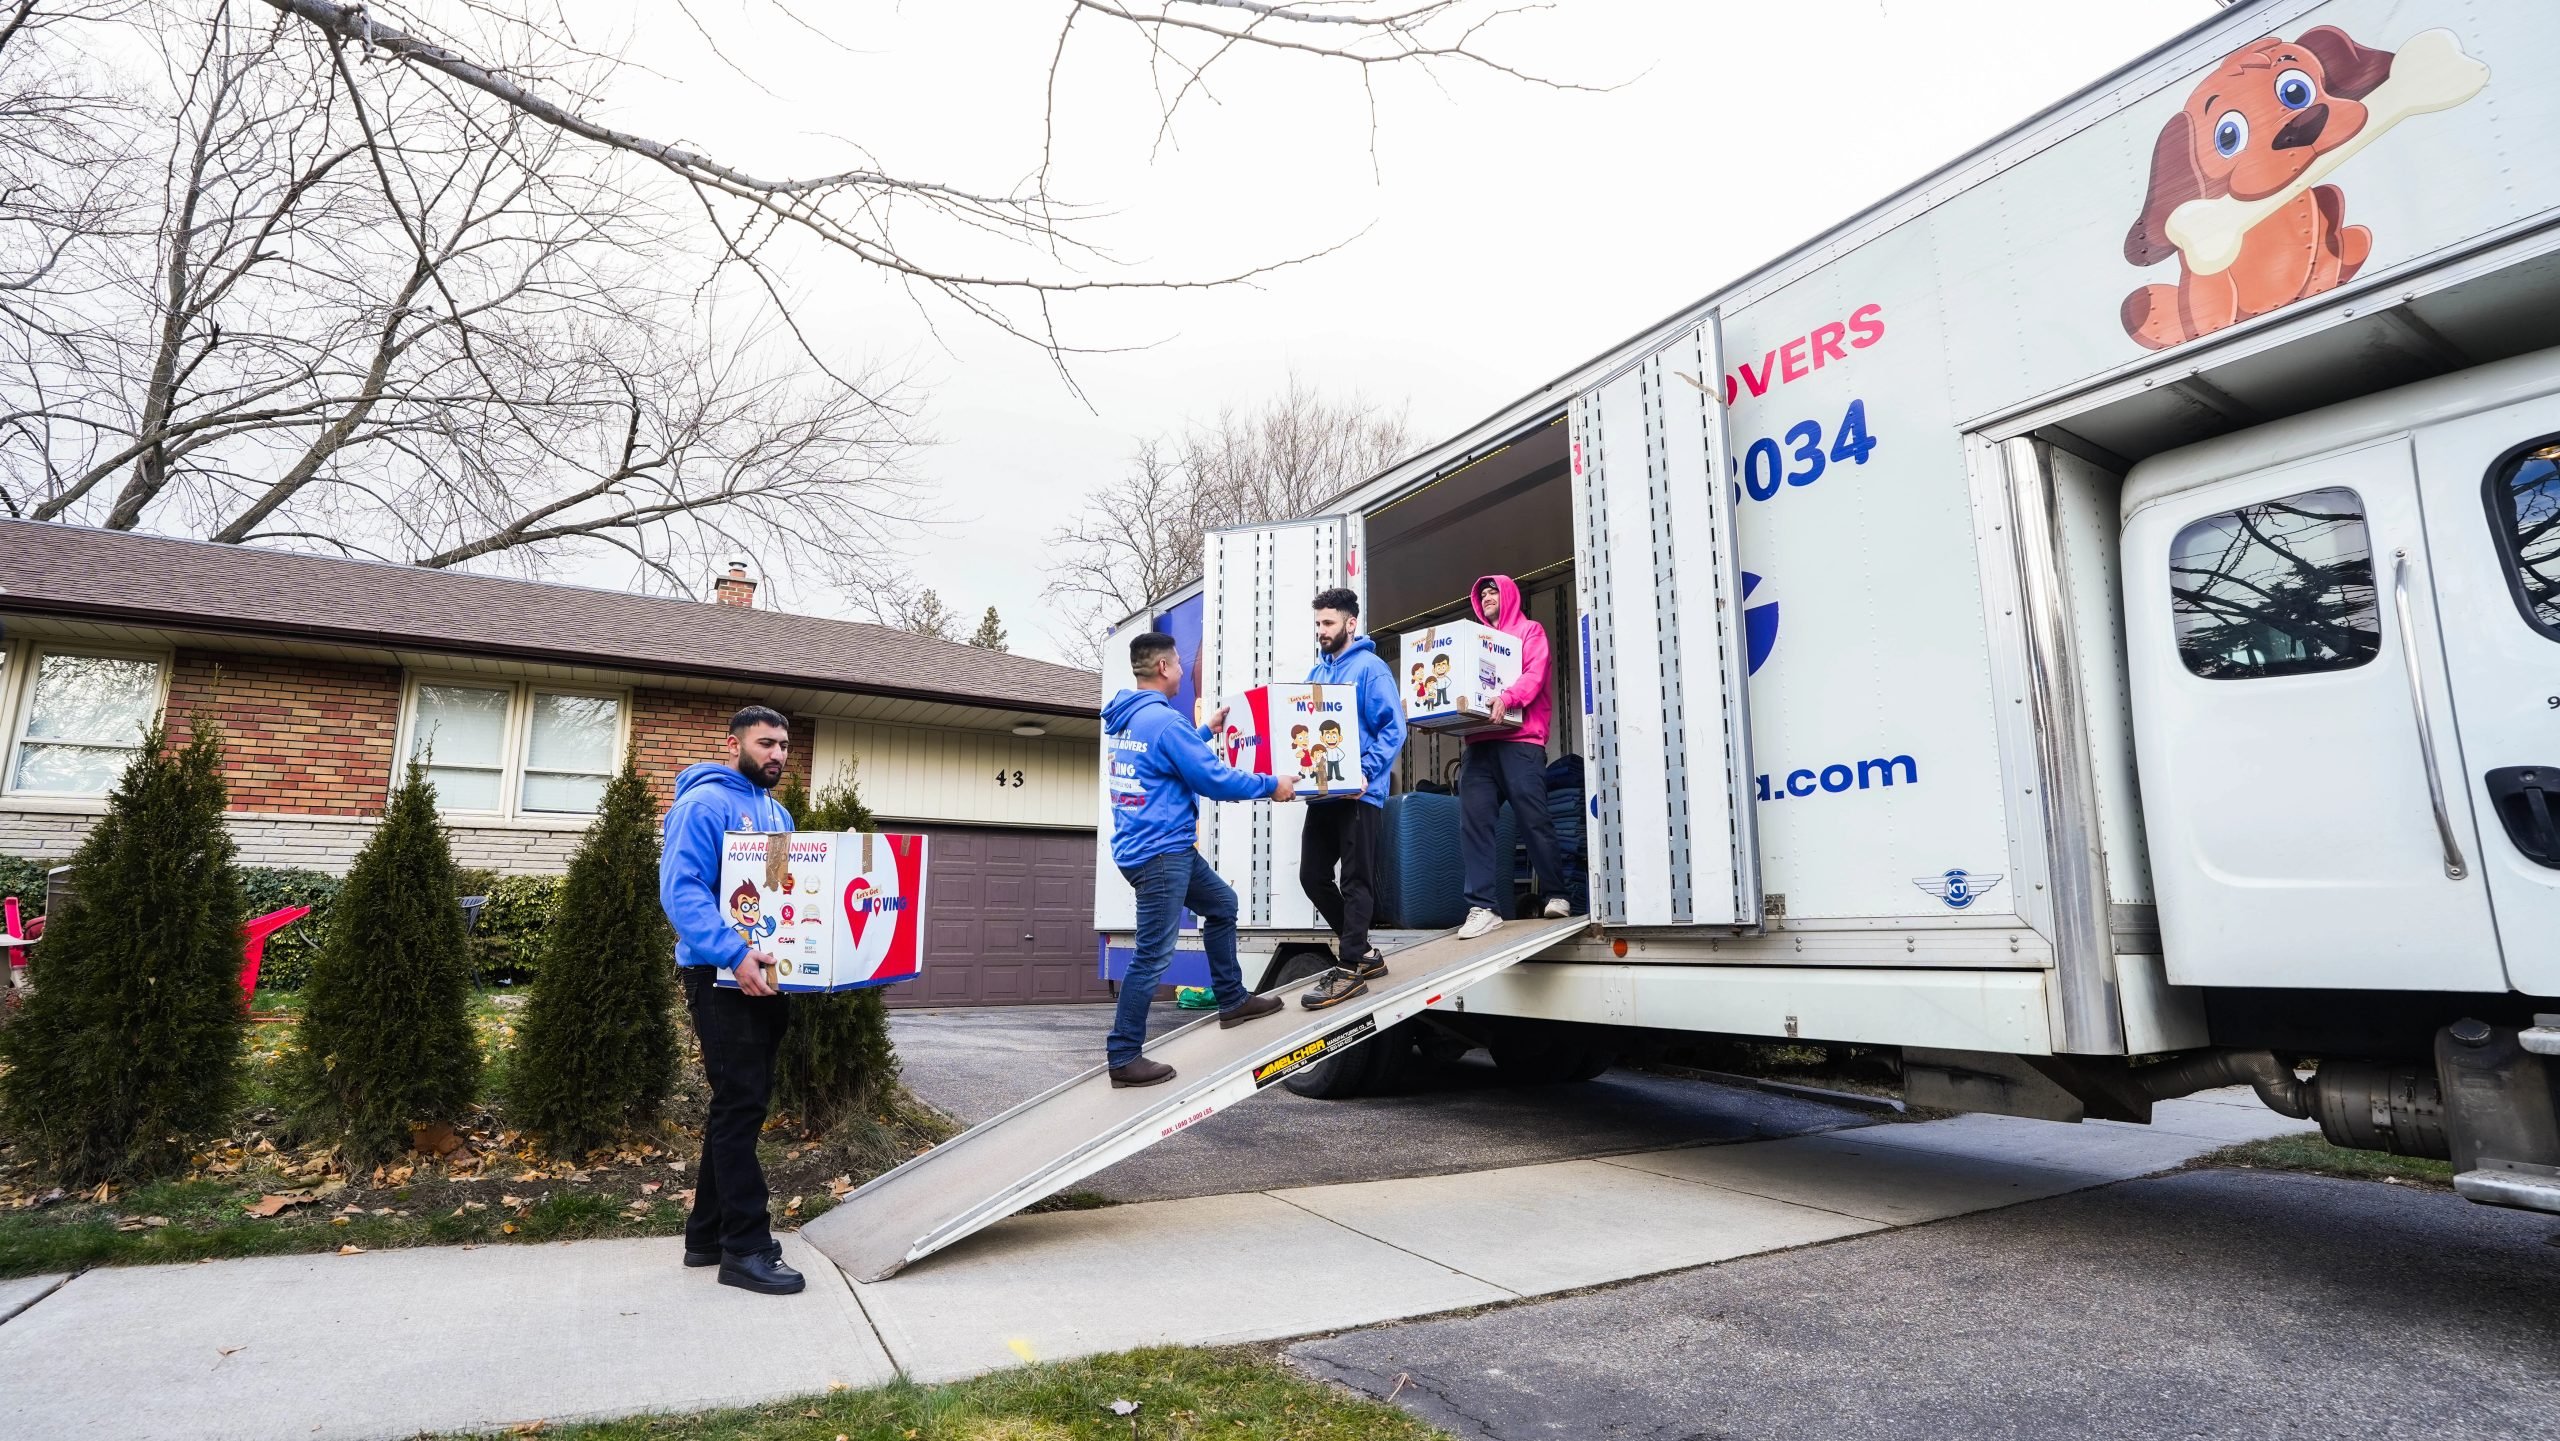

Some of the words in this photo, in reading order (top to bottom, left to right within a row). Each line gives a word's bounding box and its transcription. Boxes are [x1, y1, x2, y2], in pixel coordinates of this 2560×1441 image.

[1416, 637, 1452, 653] MVING
[1482, 639, 1511, 656] MOVING
[996, 769, 1024, 788] 43
[730, 841, 769, 852] AWAR
[856, 890, 869, 900] Let's
[869, 888, 879, 896] Get
[1948, 883, 1967, 894] KT
[862, 896, 908, 916] MOVING
